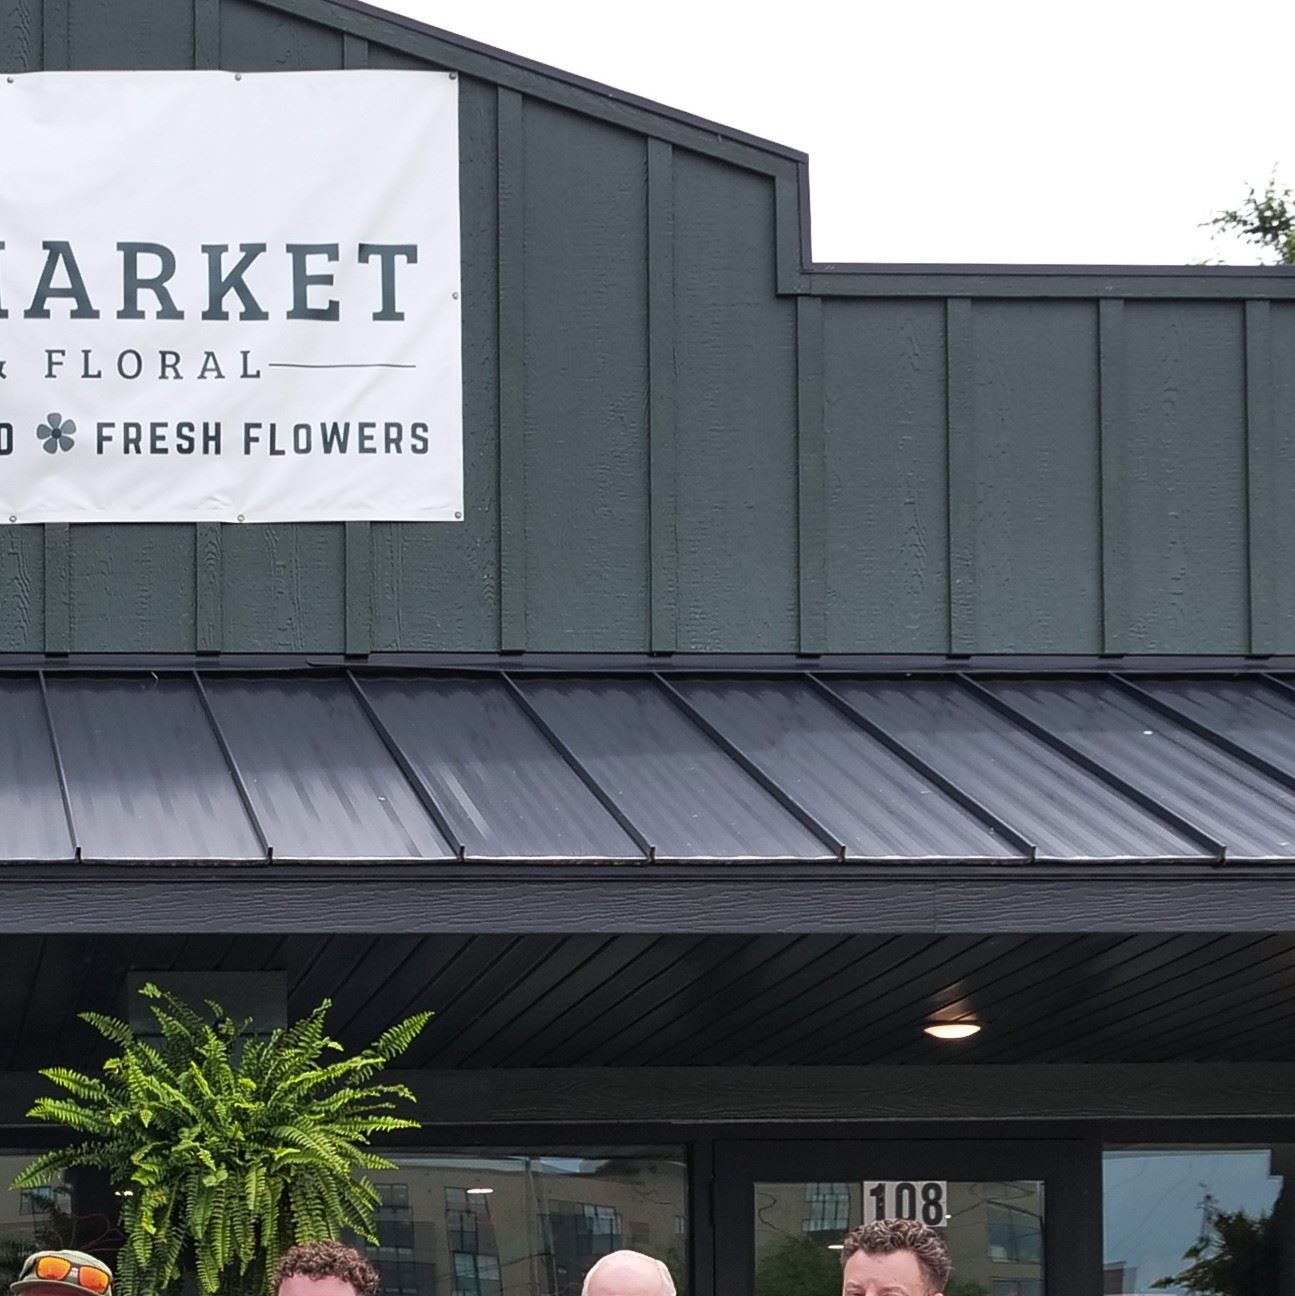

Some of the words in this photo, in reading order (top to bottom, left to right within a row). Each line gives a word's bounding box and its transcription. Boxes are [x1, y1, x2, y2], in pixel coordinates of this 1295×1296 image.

[43, 348, 262, 381] FLORAL
[95, 420, 222, 456] FRESH
[243, 420, 430, 457] FLOWERS
[869, 1182, 943, 1226] 108
